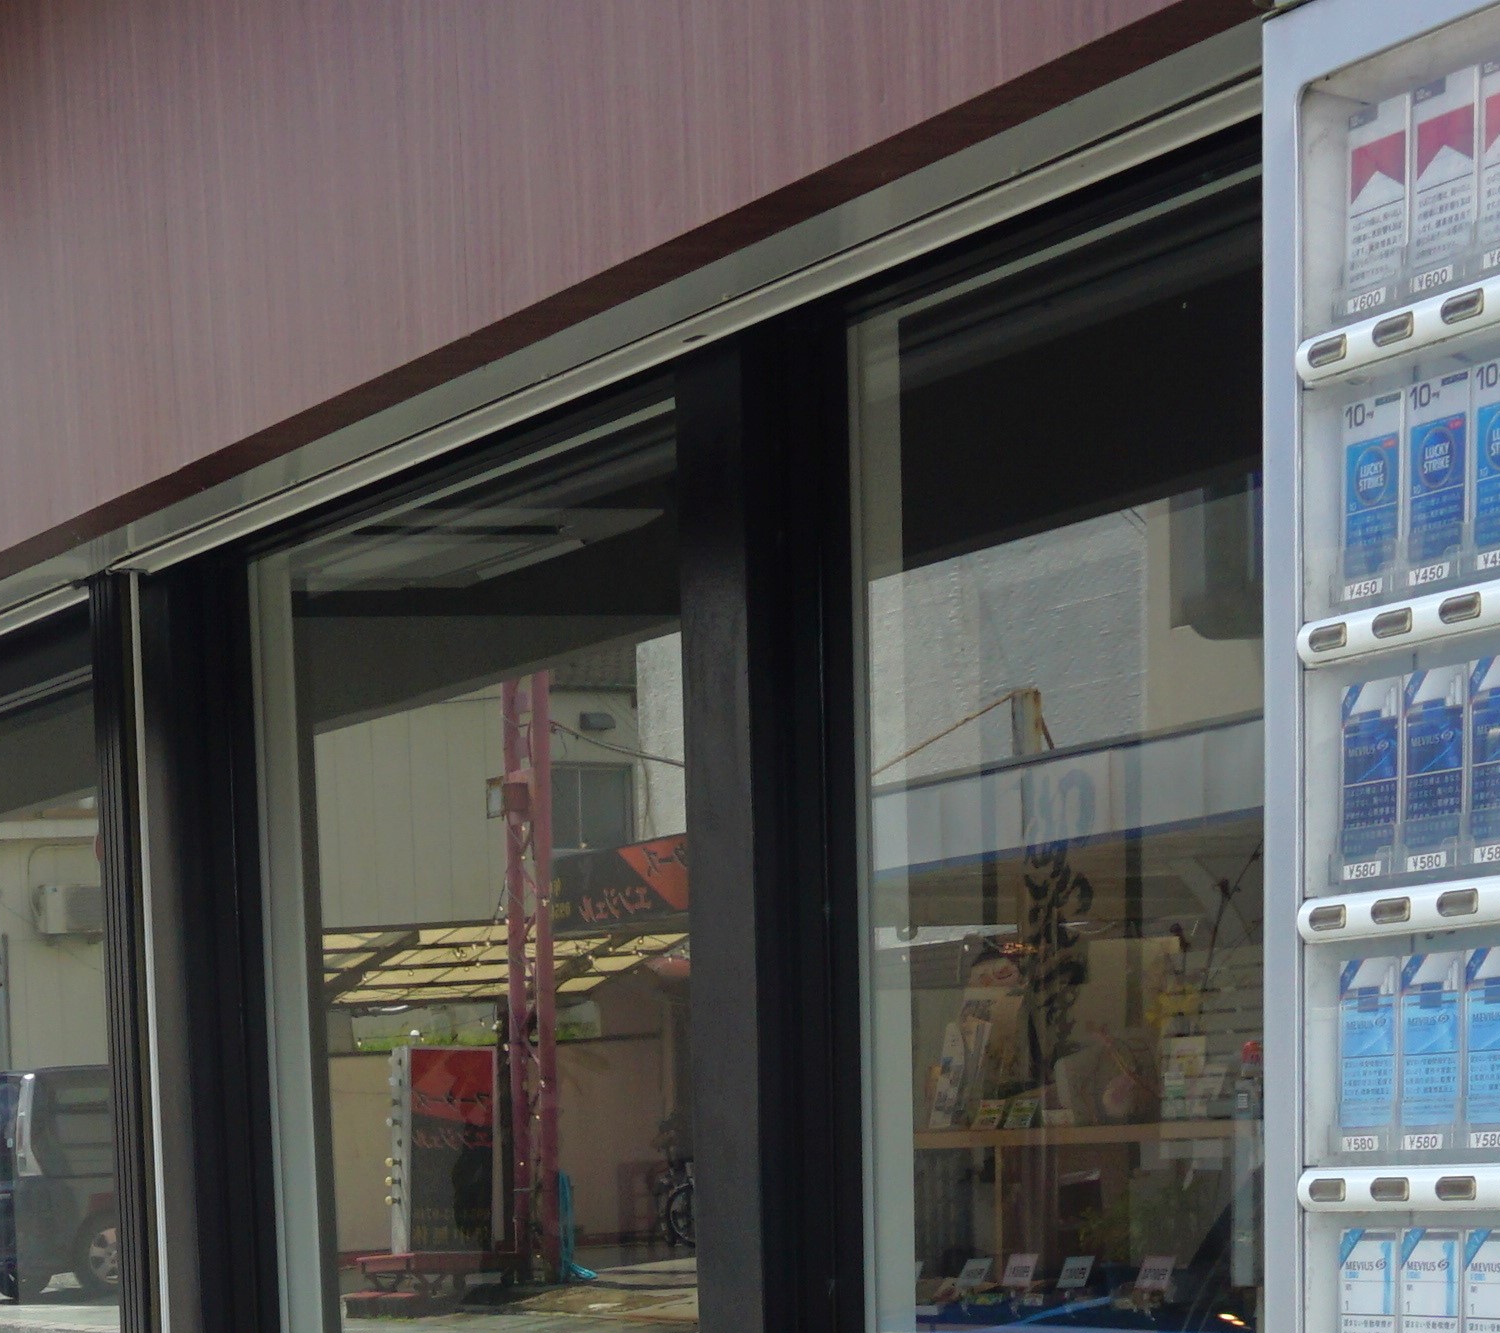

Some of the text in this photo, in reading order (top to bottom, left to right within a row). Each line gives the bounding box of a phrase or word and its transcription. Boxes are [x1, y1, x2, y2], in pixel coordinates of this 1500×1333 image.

[1418, 269, 1448, 290] ¥600
[1352, 291, 1380, 312] ¥600
[1424, 443, 1450, 463] LUCKY
[1360, 461, 1384, 479] LUCKY
[1423, 455, 1451, 475] STRIKE
[1358, 473, 1384, 491] STRIKE
[1414, 565, 1444, 582] ¥450
[1350, 580, 1378, 598] ¥450
[1348, 862, 1376, 878] ¥580
[1411, 853, 1442, 870] ¥580
[1346, 1138, 1374, 1151] ¥580
[1409, 1135, 1438, 1149] ¥580
[1345, 1260, 1375, 1272] MEVIUS
[1407, 1260, 1437, 1272] MEVIUS
[1471, 1261, 1500, 1273] MEVIUS
